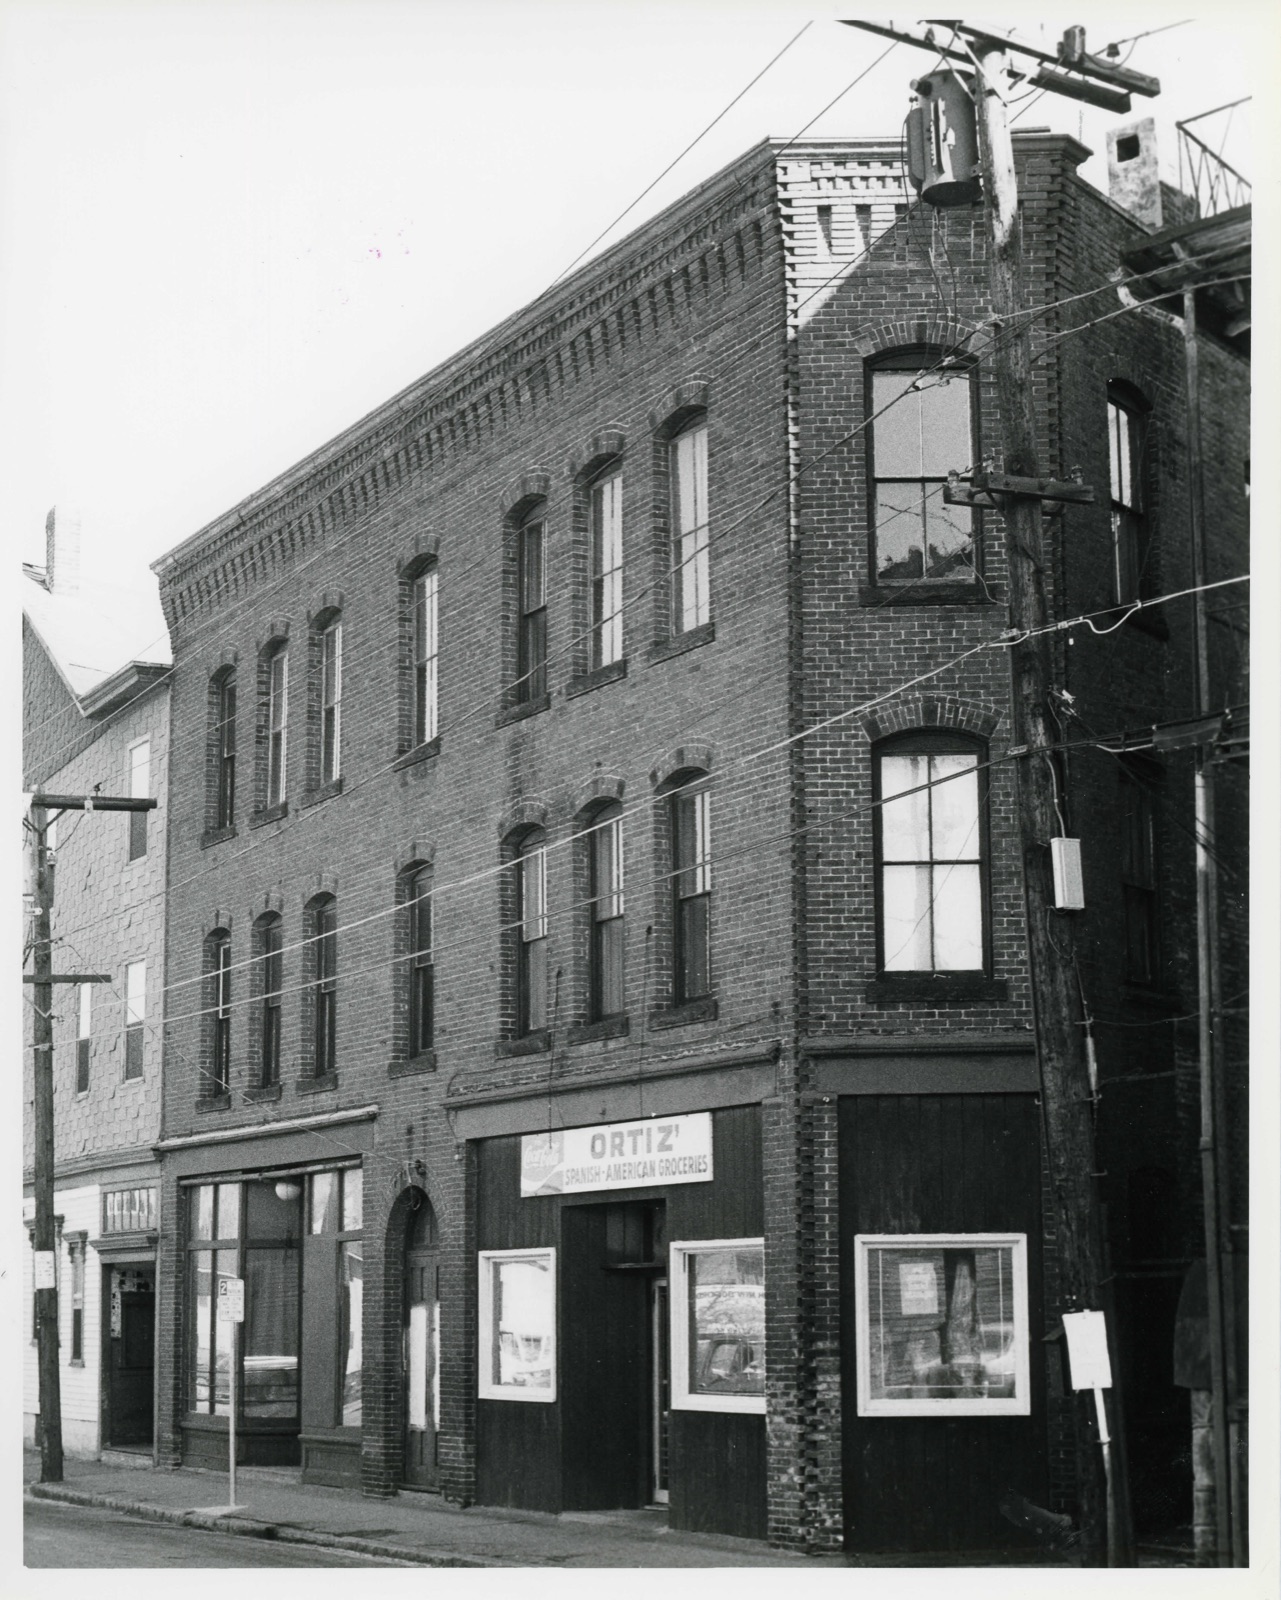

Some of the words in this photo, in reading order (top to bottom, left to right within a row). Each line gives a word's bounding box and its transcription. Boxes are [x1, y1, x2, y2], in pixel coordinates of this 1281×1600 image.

[590, 1124, 680, 1159] ORTIZ'
[658, 1155, 708, 1177] GROCERIES
[220, 1282, 227, 1294] 2
